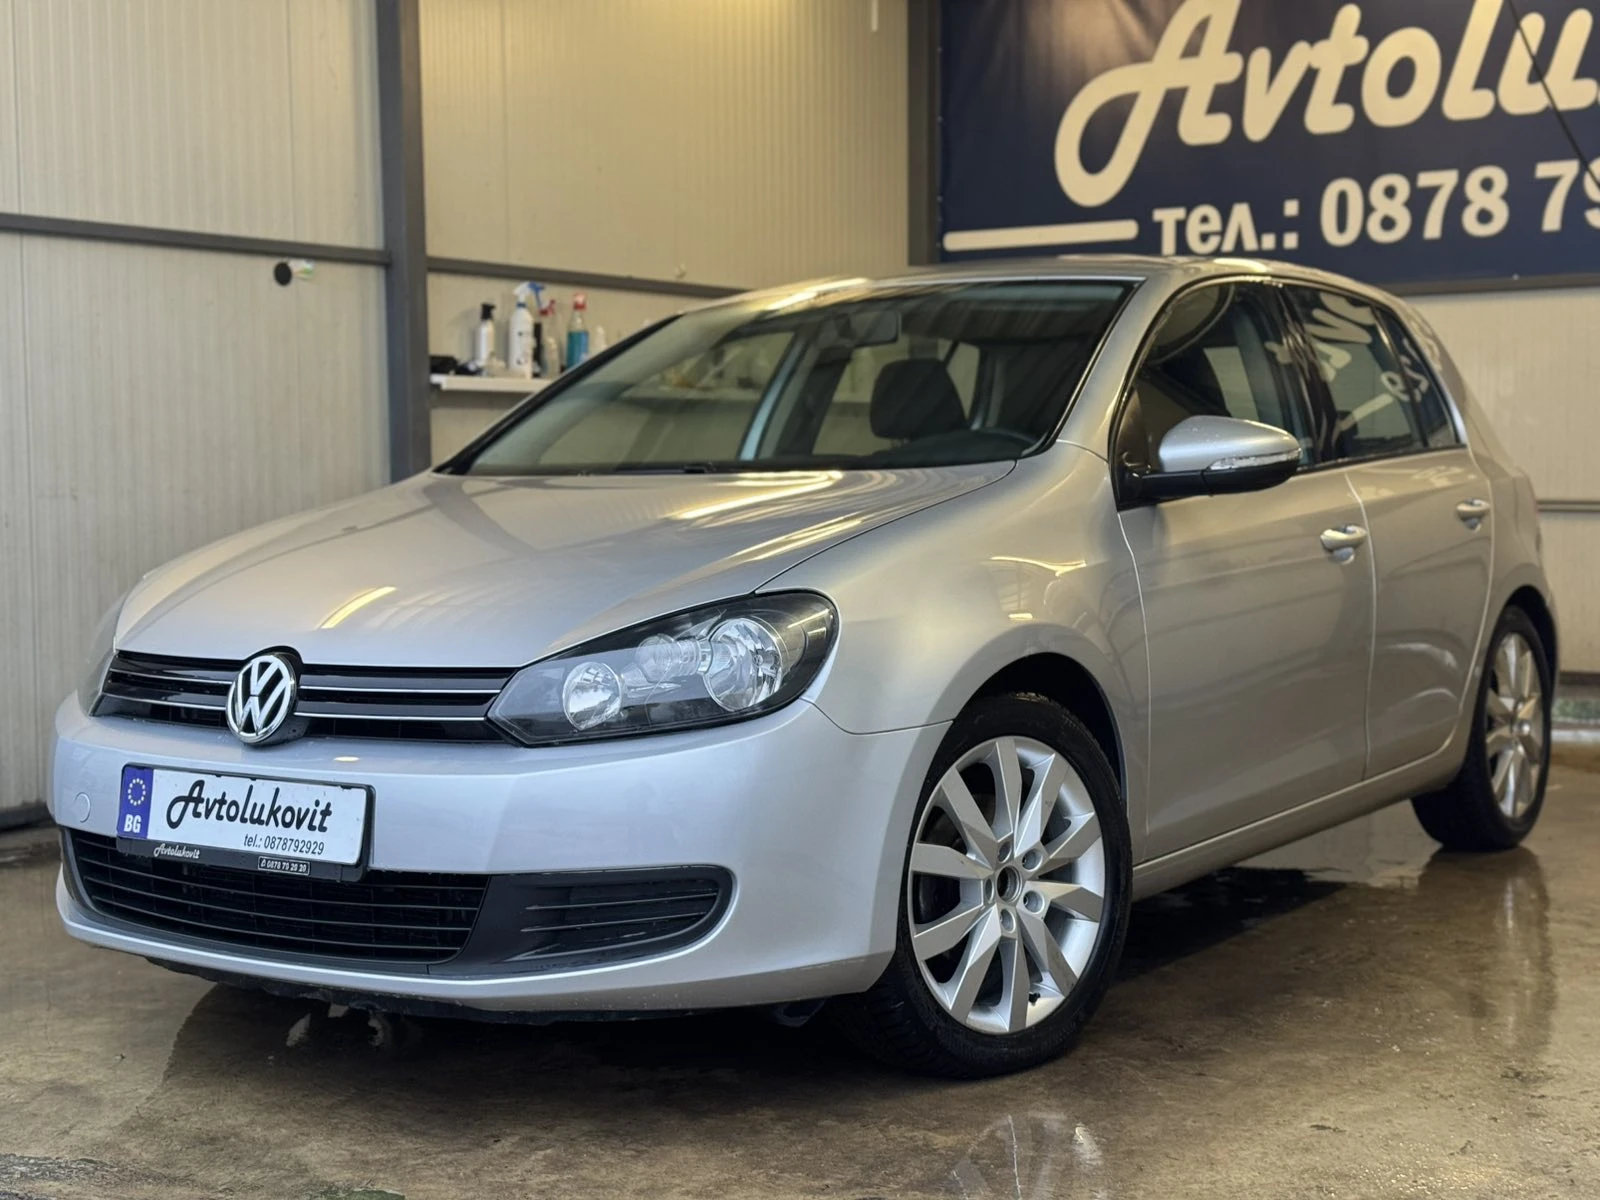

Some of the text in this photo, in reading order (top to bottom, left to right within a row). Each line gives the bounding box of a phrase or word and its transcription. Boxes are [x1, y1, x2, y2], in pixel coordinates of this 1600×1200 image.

[1054, 0, 1600, 207] Avtolu
[1320, 165, 1509, 248] 0878
[123, 813, 142, 834] BG
[165, 779, 333, 833] Avtolukovit
[243, 833, 325, 855] tel.: 0878792929
